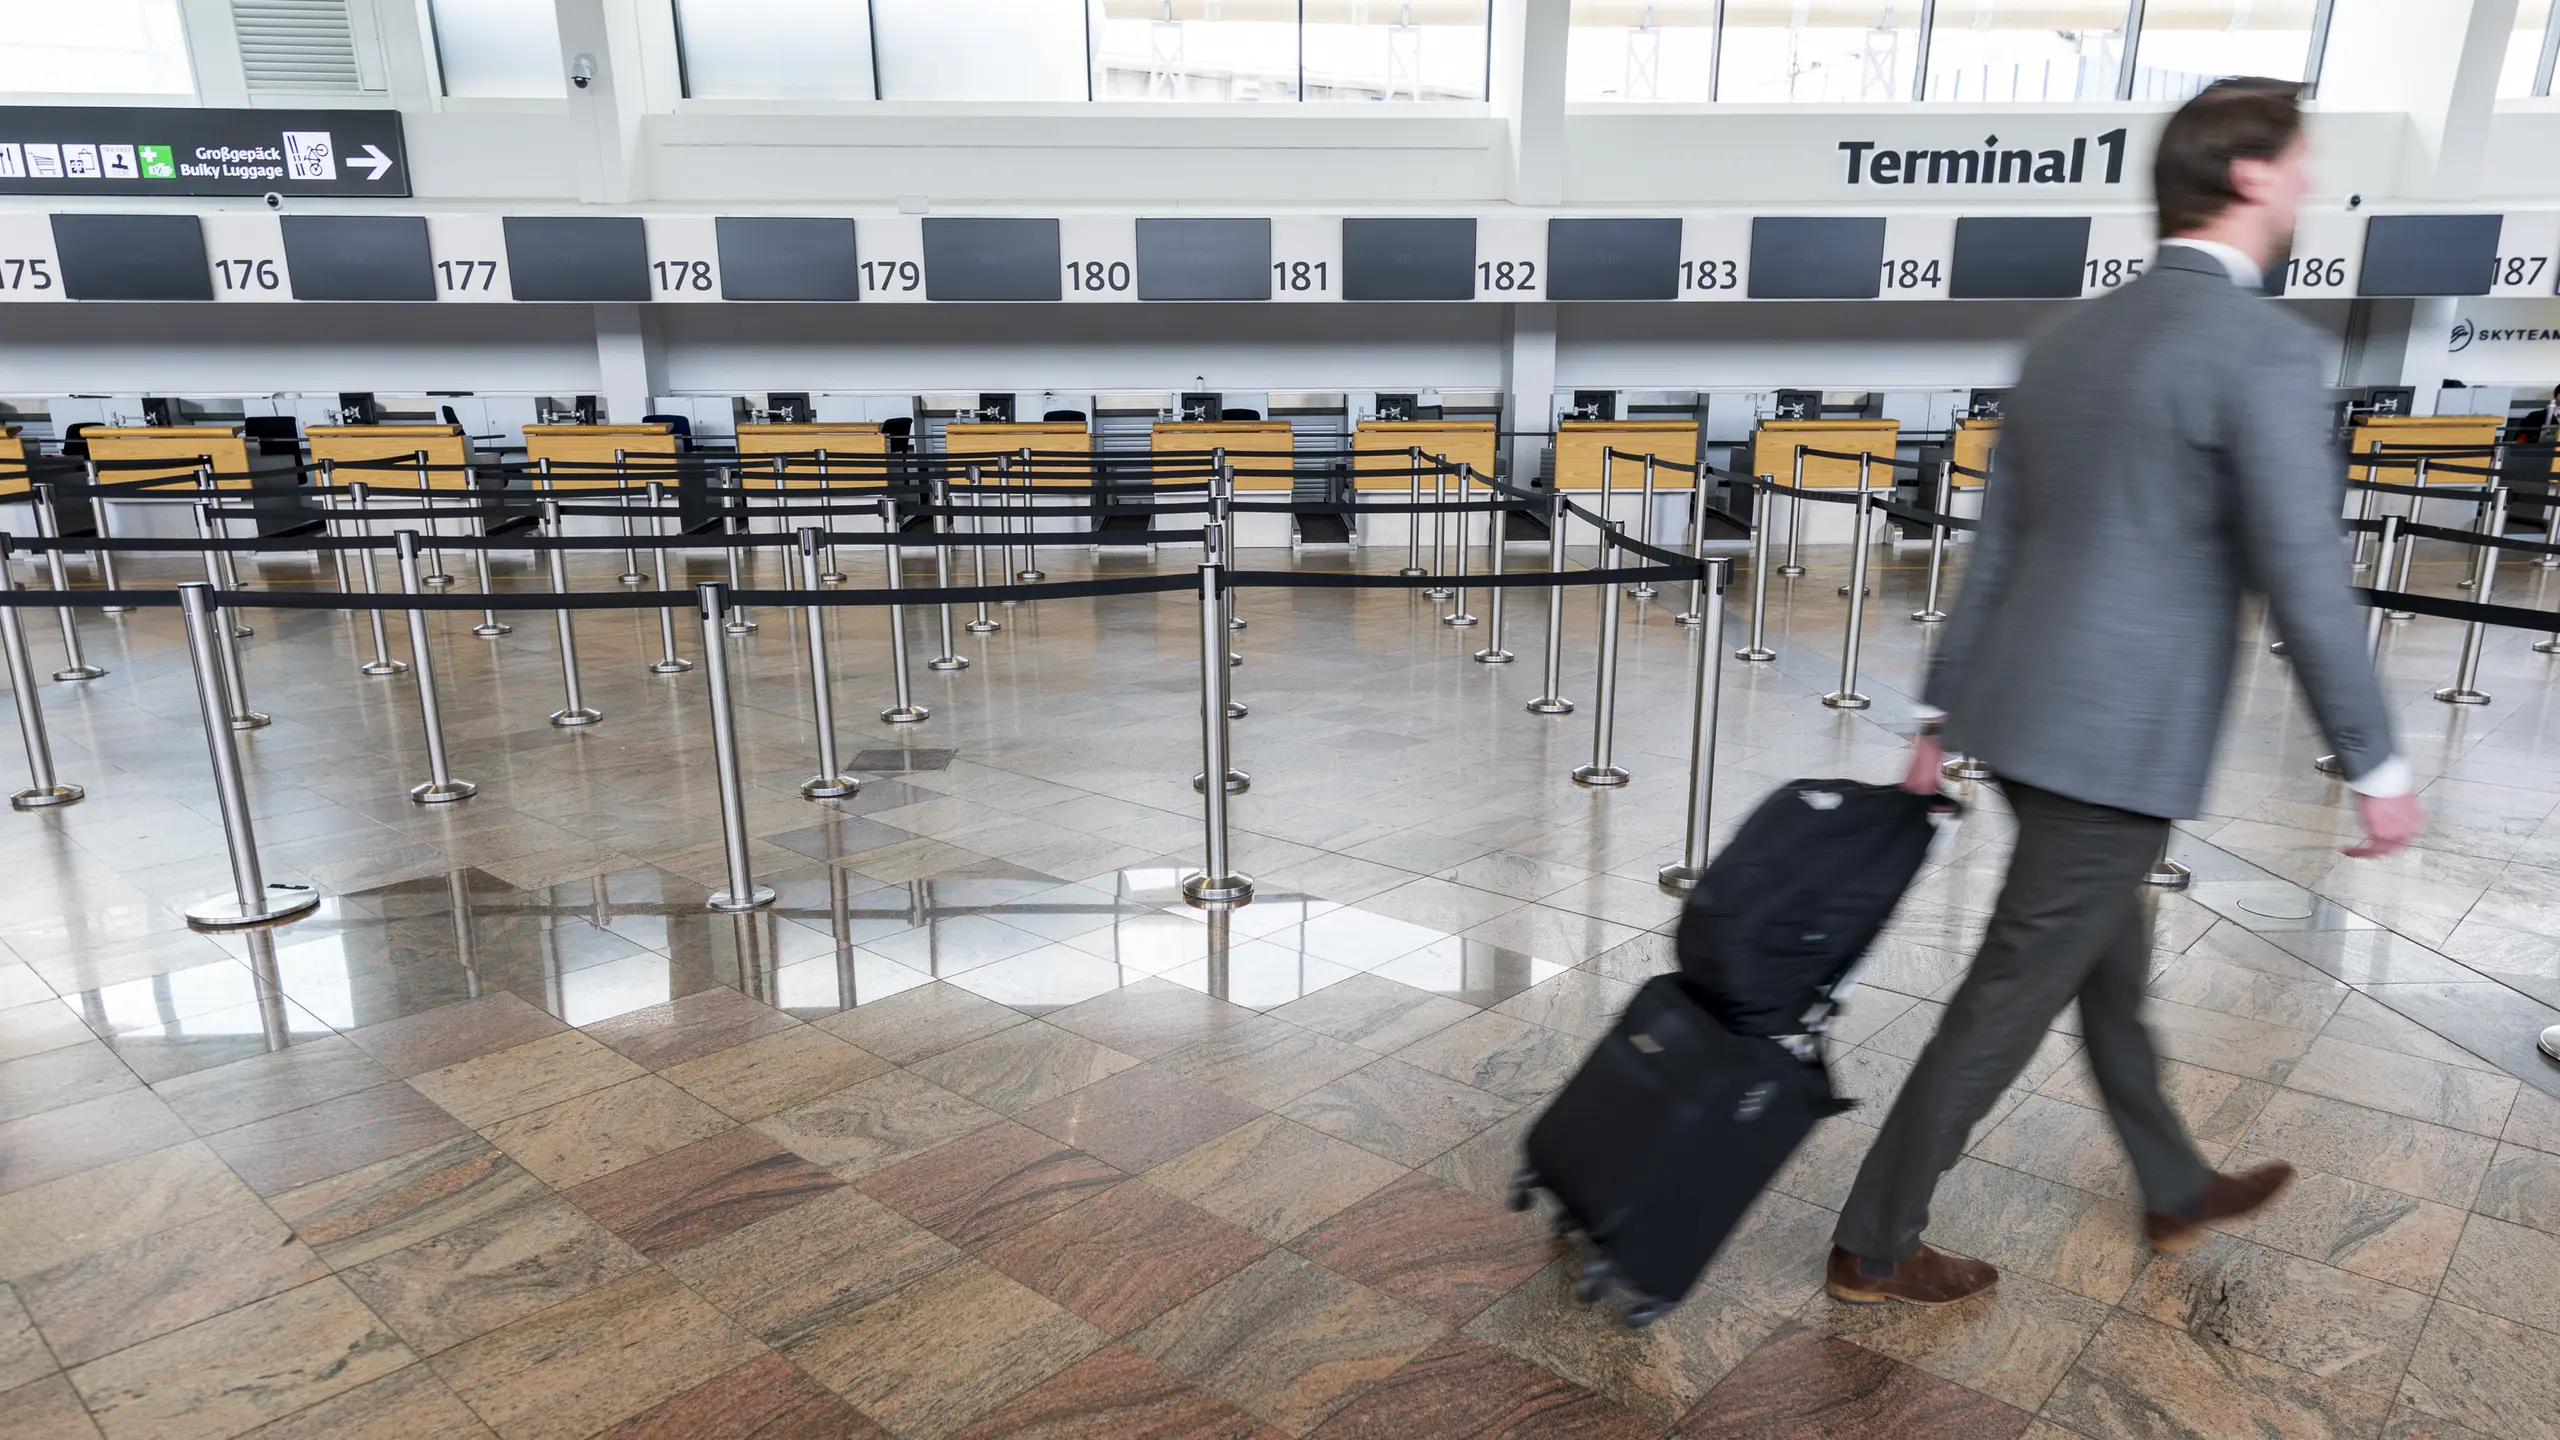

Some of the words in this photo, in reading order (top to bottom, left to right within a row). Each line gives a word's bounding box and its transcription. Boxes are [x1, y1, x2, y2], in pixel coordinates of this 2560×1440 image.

[195, 146, 282, 163] Großgepäck
[1839, 134, 2087, 184] Terminal
[2097, 128, 2127, 184] 1
[180, 163, 220, 179] Bulky
[223, 164, 284, 180] Luggage
[215, 259, 280, 290] 176
[437, 261, 497, 291] 177
[653, 260, 713, 292] 178
[860, 260, 921, 292] 179
[1066, 261, 1130, 292] 180
[1273, 261, 1327, 291] 181
[1478, 261, 1536, 291] 182
[1680, 260, 1737, 290] 183
[1883, 259, 1941, 289] 184
[2086, 258, 2144, 288] 185
[2288, 257, 2346, 287] 186
[2492, 256, 2548, 286] 187
